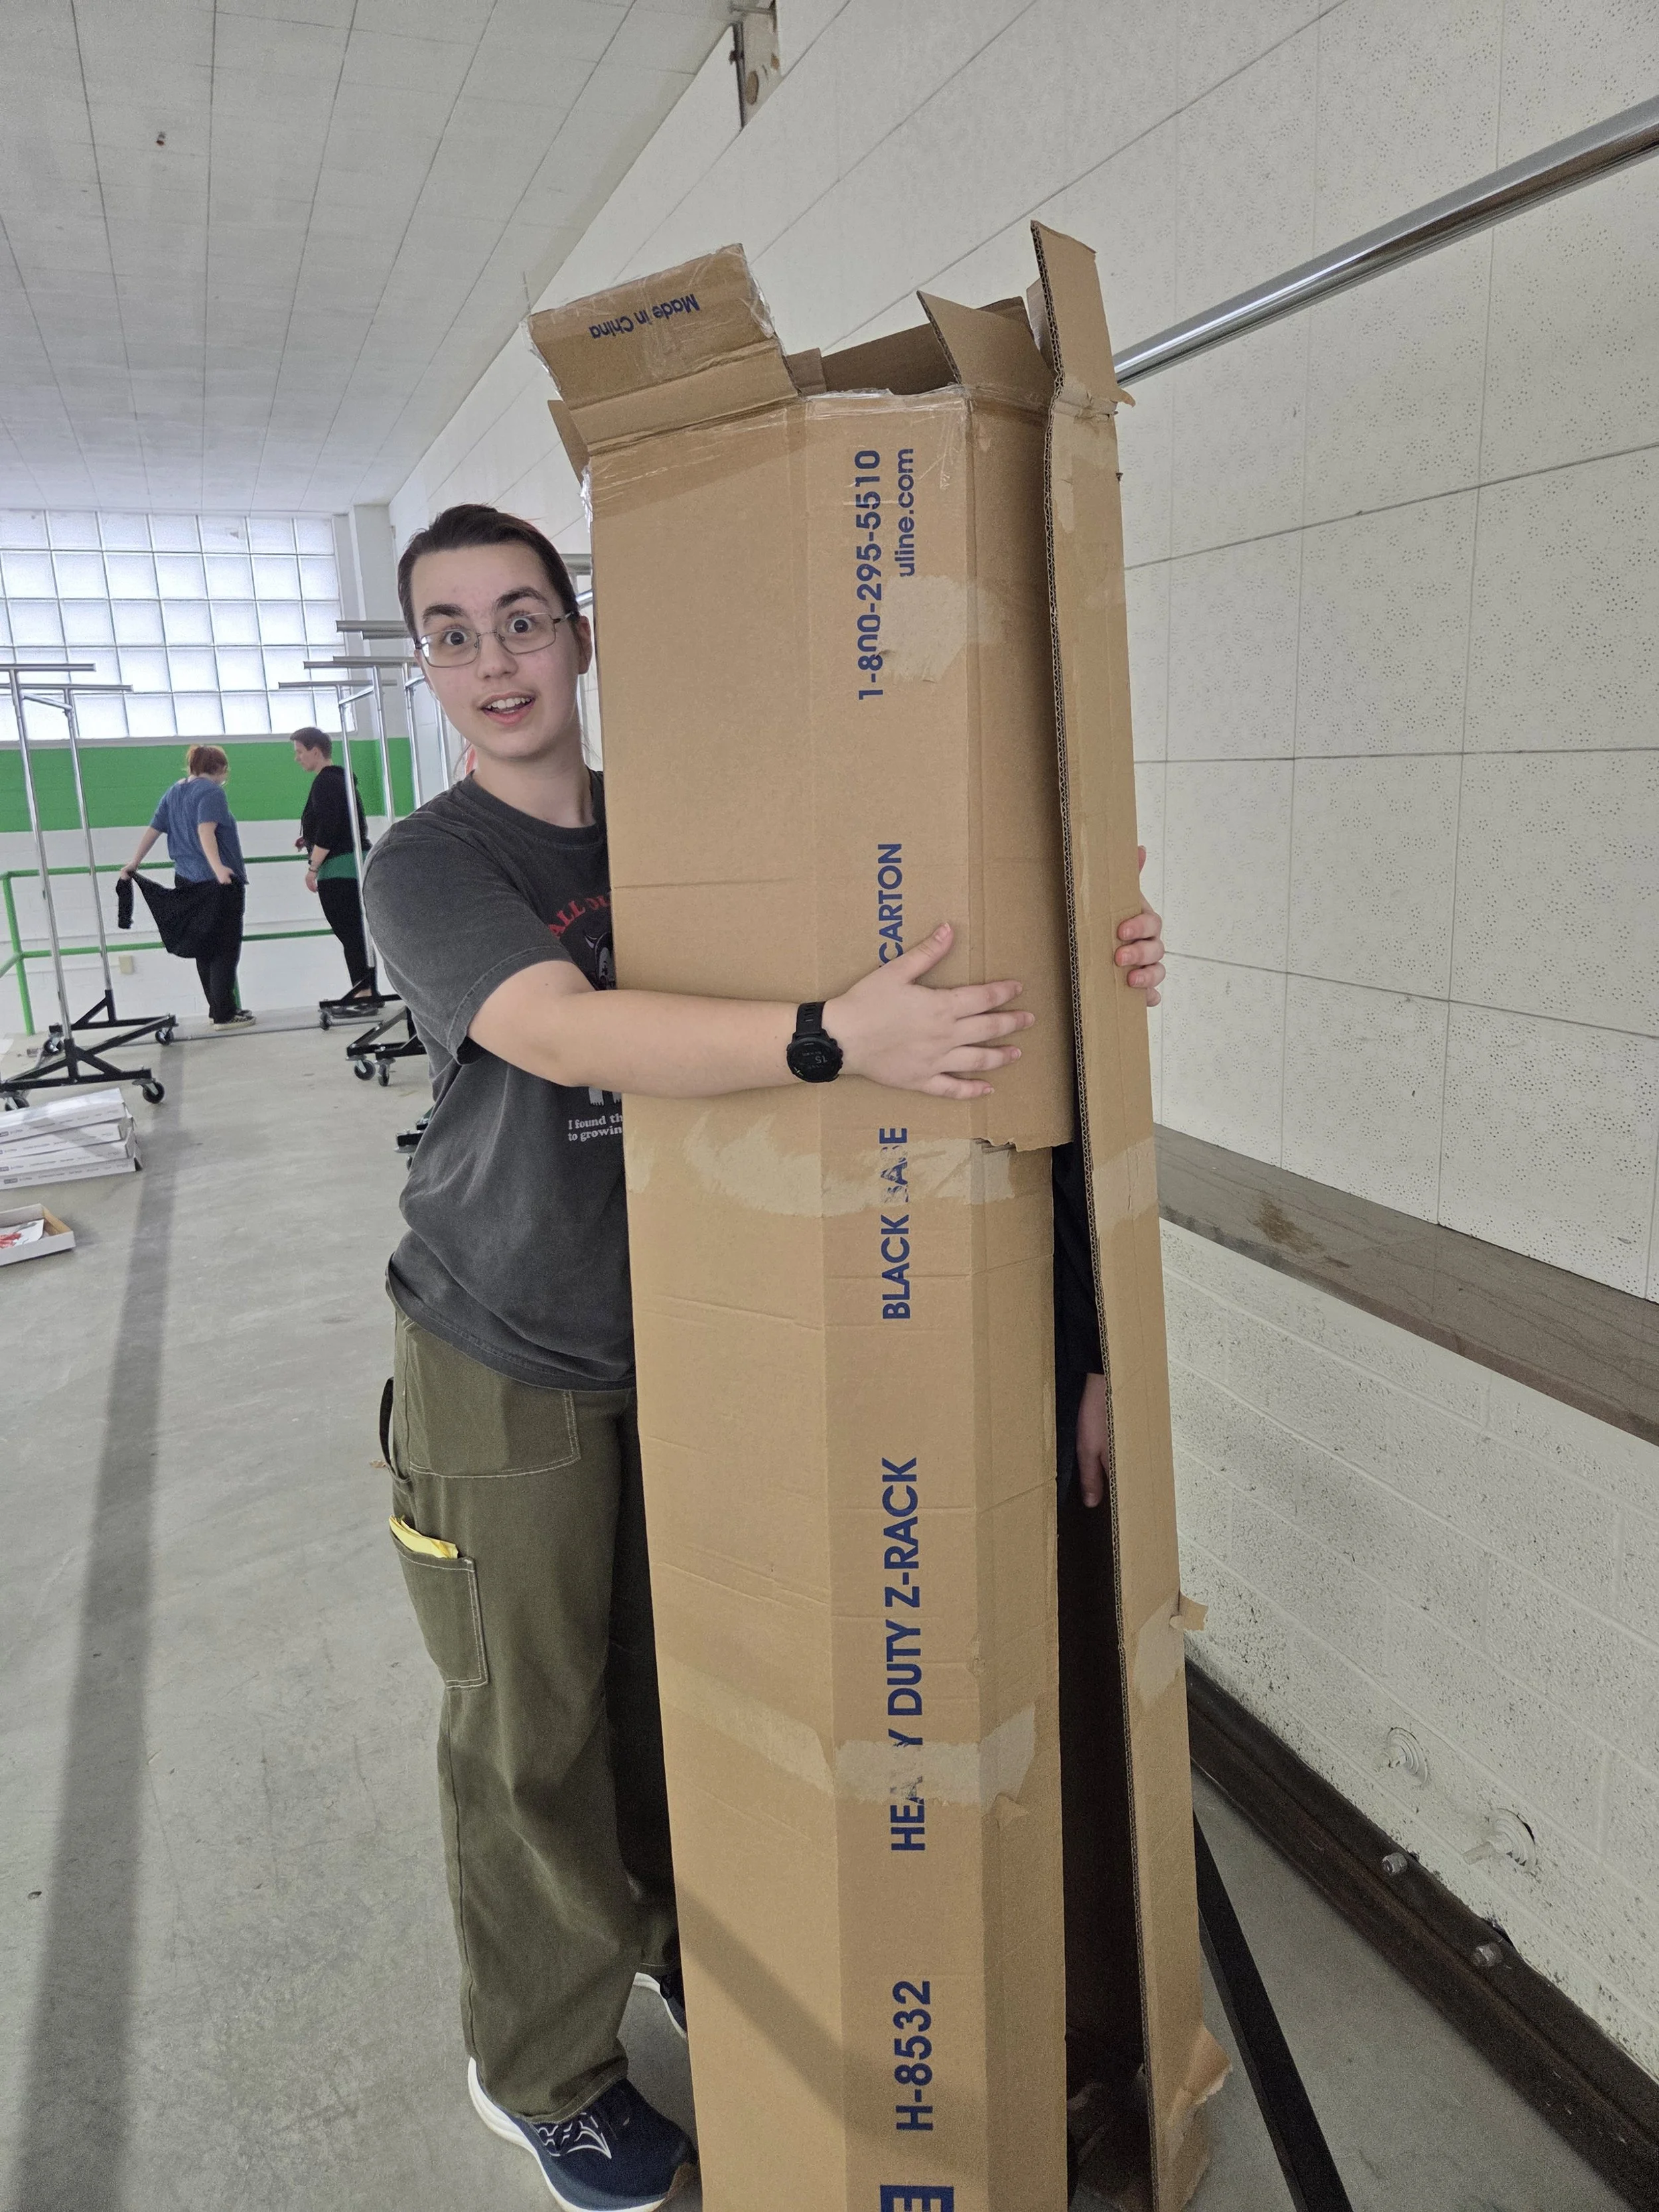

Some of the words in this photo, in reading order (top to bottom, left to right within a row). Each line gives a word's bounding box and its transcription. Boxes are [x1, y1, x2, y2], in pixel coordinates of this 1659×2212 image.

[589, 315, 634, 339] China
[634, 310, 652, 325] in
[652, 294, 700, 319] Made
[895, 448, 915, 577] uline.com
[855, 450, 883, 700] 1-800-295-5510
[568, 1120, 573, 1130] I
[575, 1116, 607, 1129] found
[568, 1132, 578, 1142] to
[580, 1126, 622, 1142] growin
[880, 1215, 910, 1319] BLACK
[881, 1457, 919, 1607] Z-RACK
[885, 1619, 922, 1716] DUTY
[889, 1728, 924, 1850] HEAY
[893, 1980, 932, 2130] H-8532
